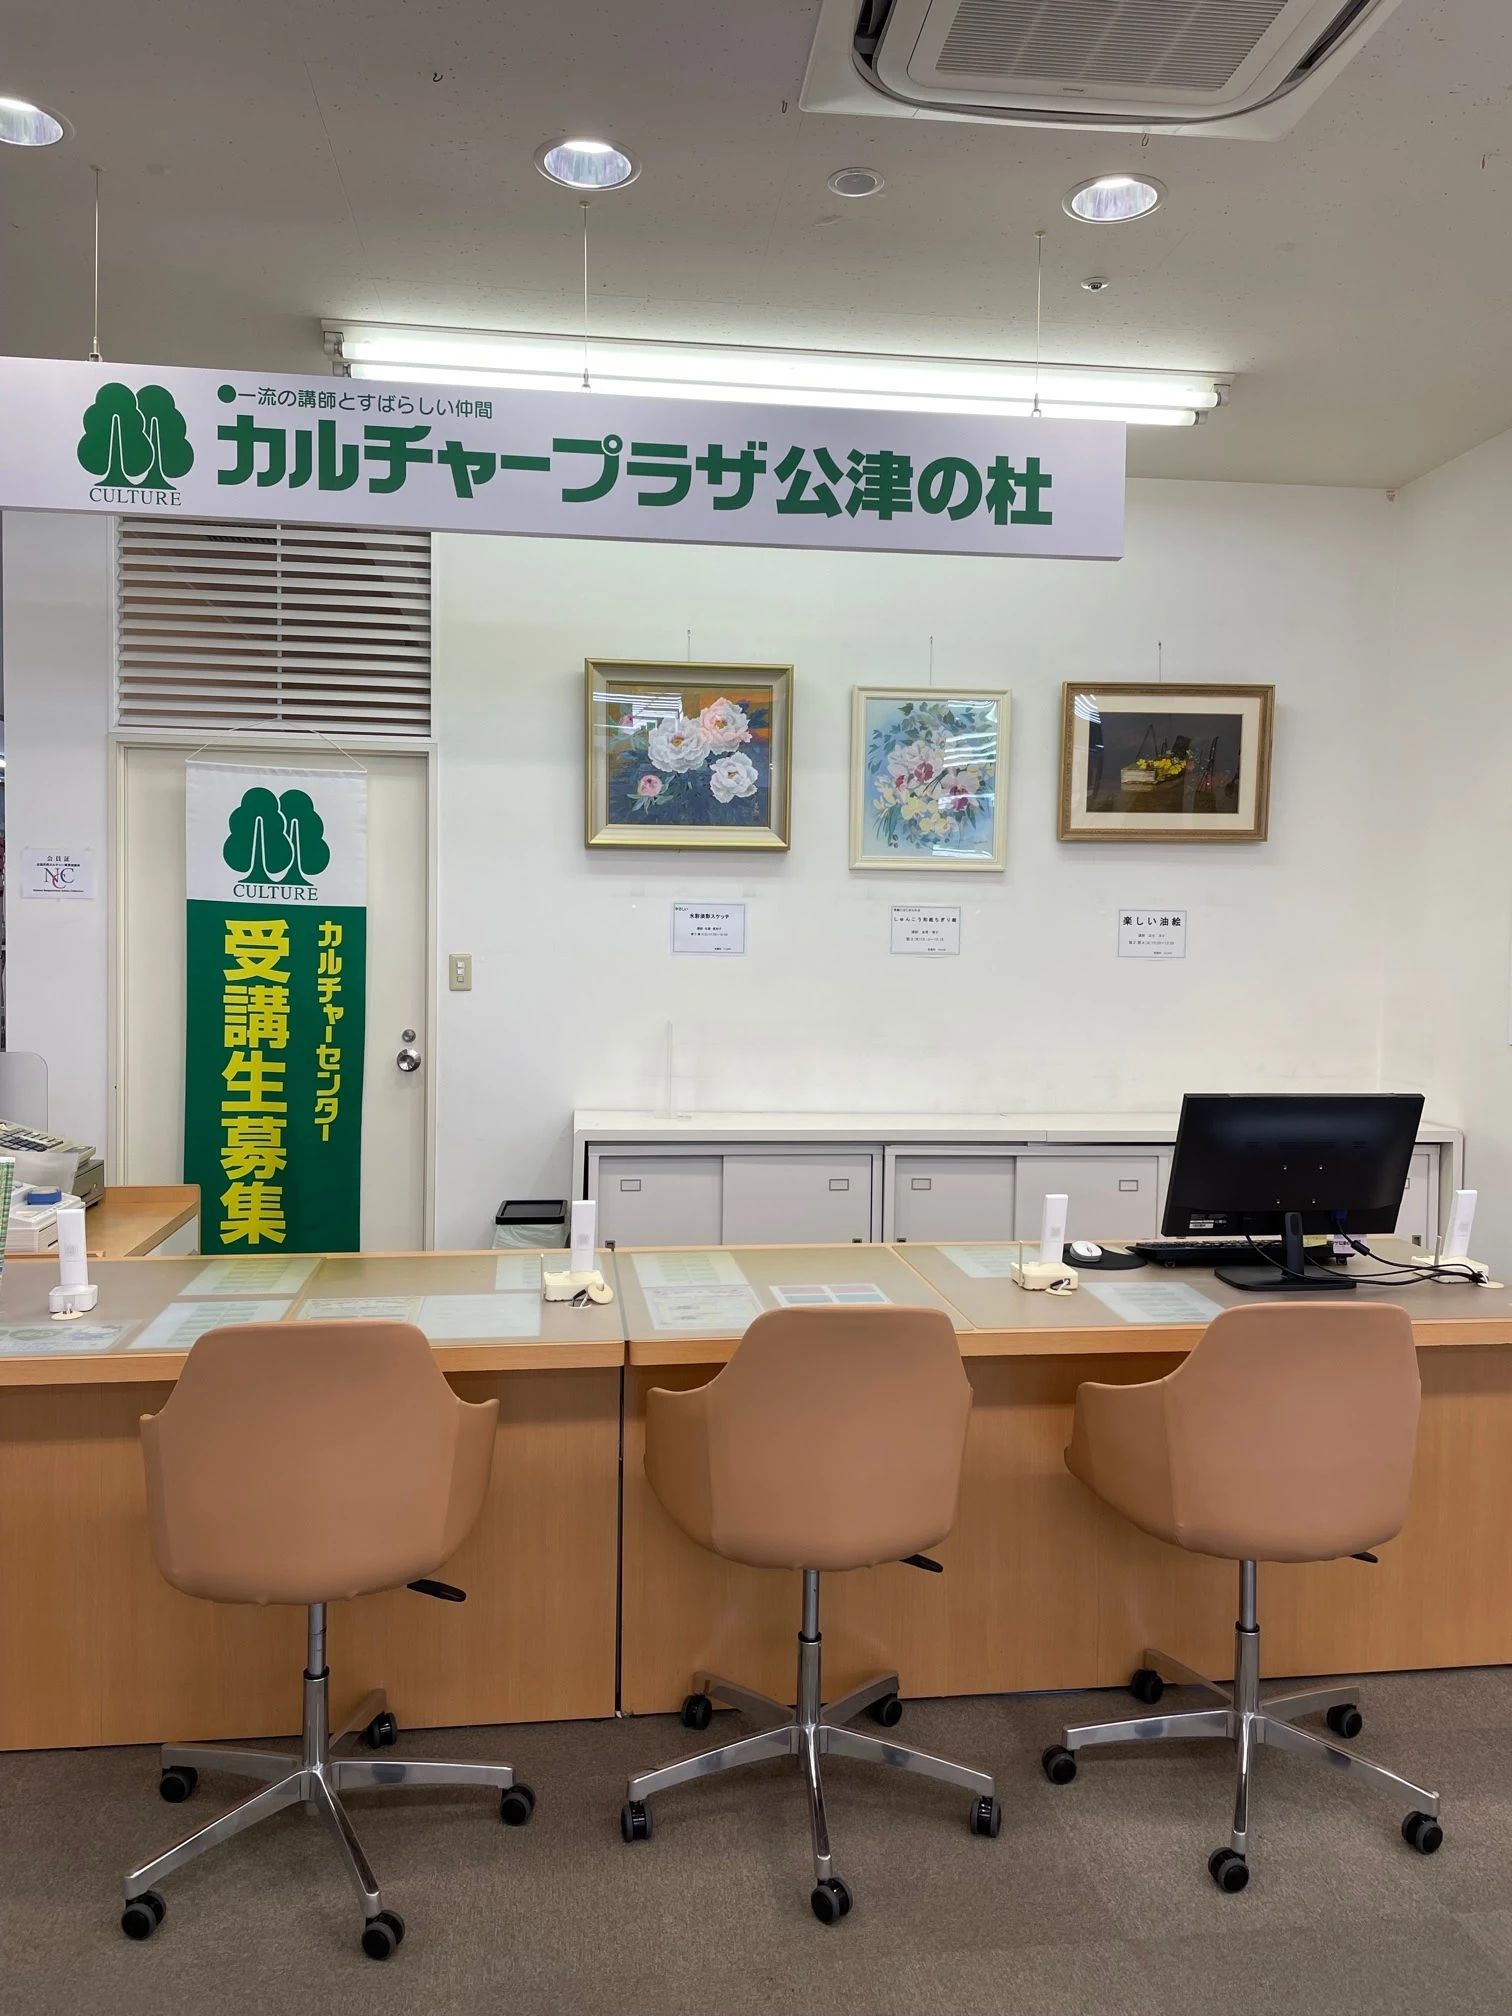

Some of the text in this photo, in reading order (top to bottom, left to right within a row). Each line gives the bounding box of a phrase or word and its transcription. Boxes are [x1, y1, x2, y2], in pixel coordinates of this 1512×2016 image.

[238, 386, 493, 420] 一流の講師とすばらしい仲間
[217, 414, 1052, 525] カルチャープラザ公津の杜
[89, 487, 182, 506] CULTURE
[232, 884, 318, 901] CULTURE
[1122, 916, 1181, 927] 楽しい油絵
[314, 920, 344, 1143] カルチャーセンター
[219, 918, 291, 1246] 受講生募集
